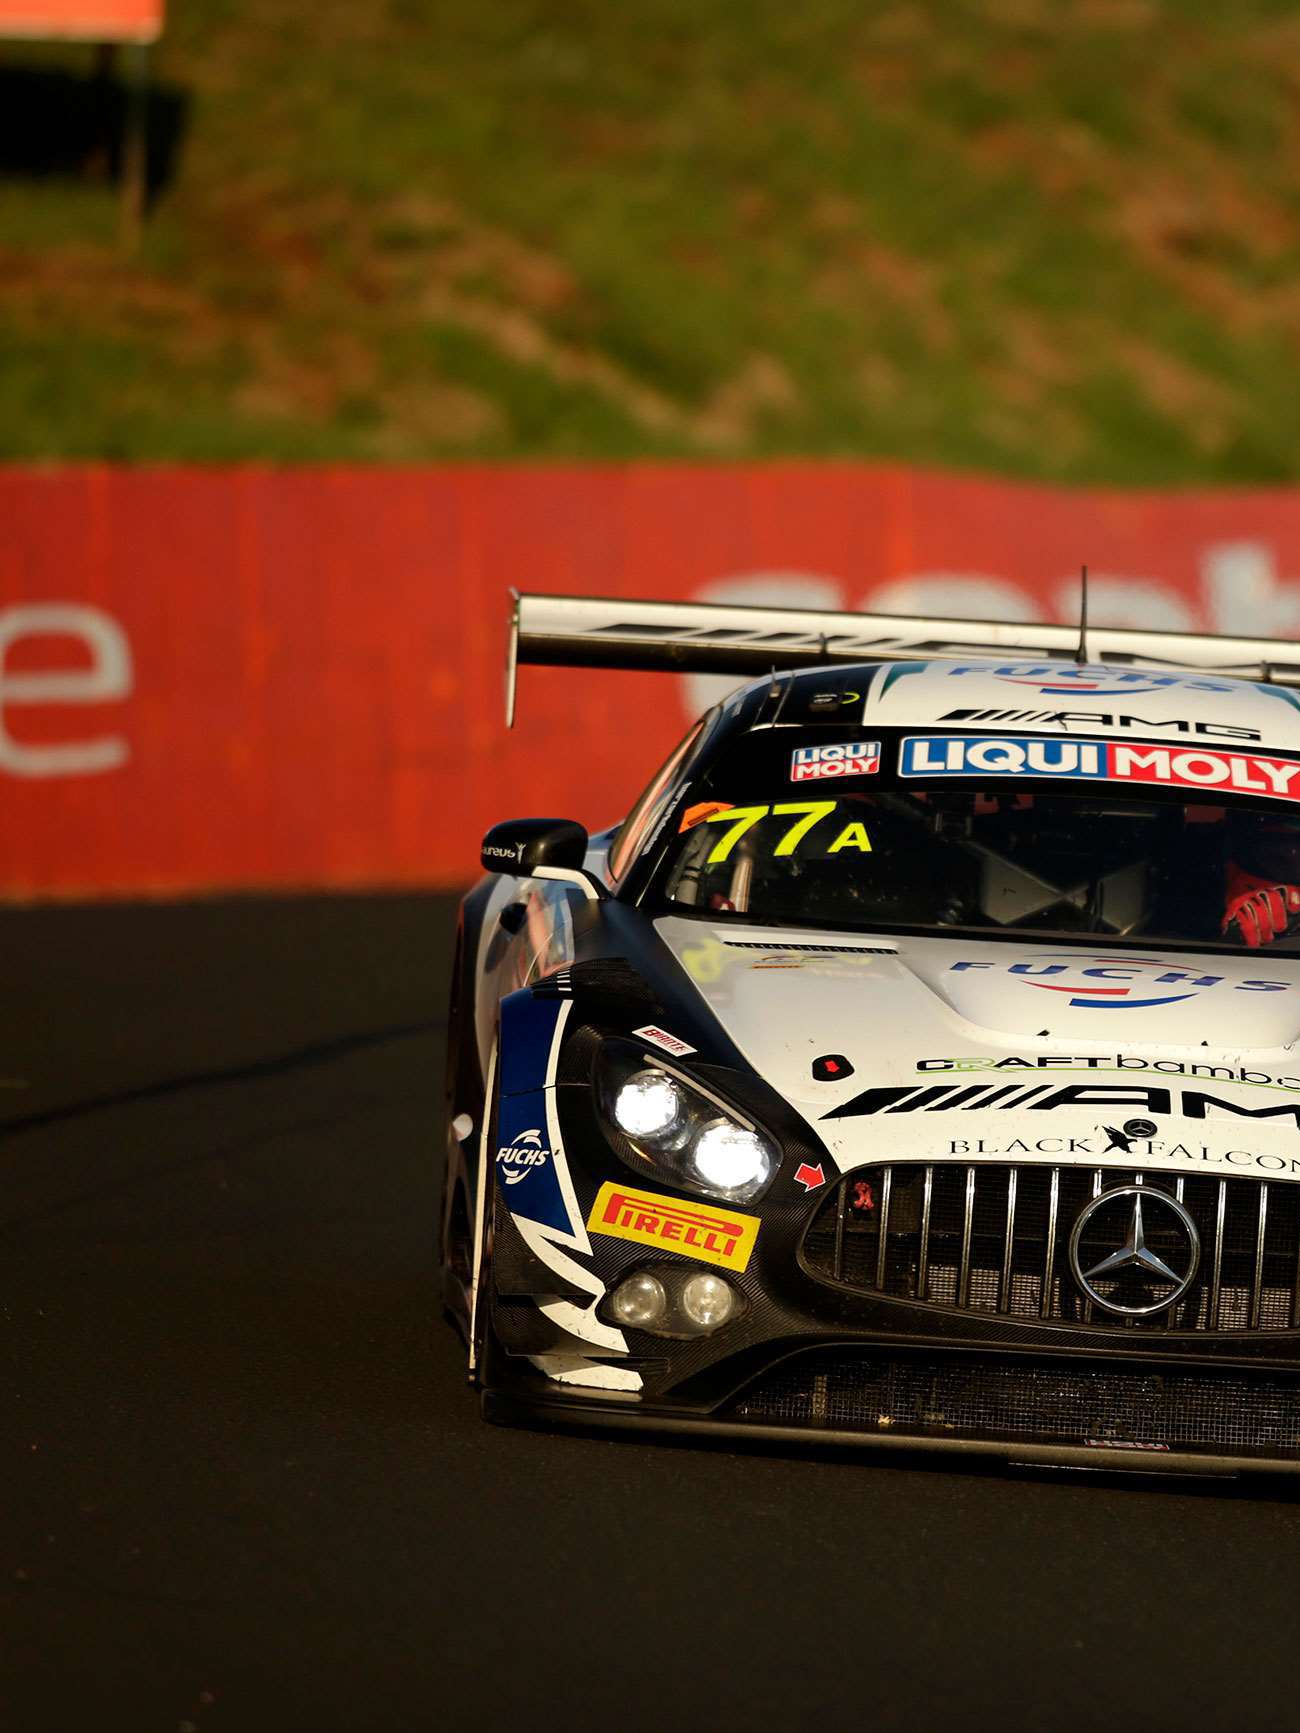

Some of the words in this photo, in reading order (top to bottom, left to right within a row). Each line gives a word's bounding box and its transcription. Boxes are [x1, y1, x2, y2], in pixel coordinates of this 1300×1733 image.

[948, 665, 1234, 692] FUCHS
[1038, 711, 1261, 741] AMG
[796, 743, 876, 763] LIQUI
[911, 741, 1098, 775] LIQUI
[795, 755, 874, 779] MOLY
[949, 961, 1293, 992] FUCHS
[496, 1147, 549, 1166] FUCHS
[948, 1137, 1095, 1155] BLACK
[602, 1193, 744, 1256] PIRELLI
